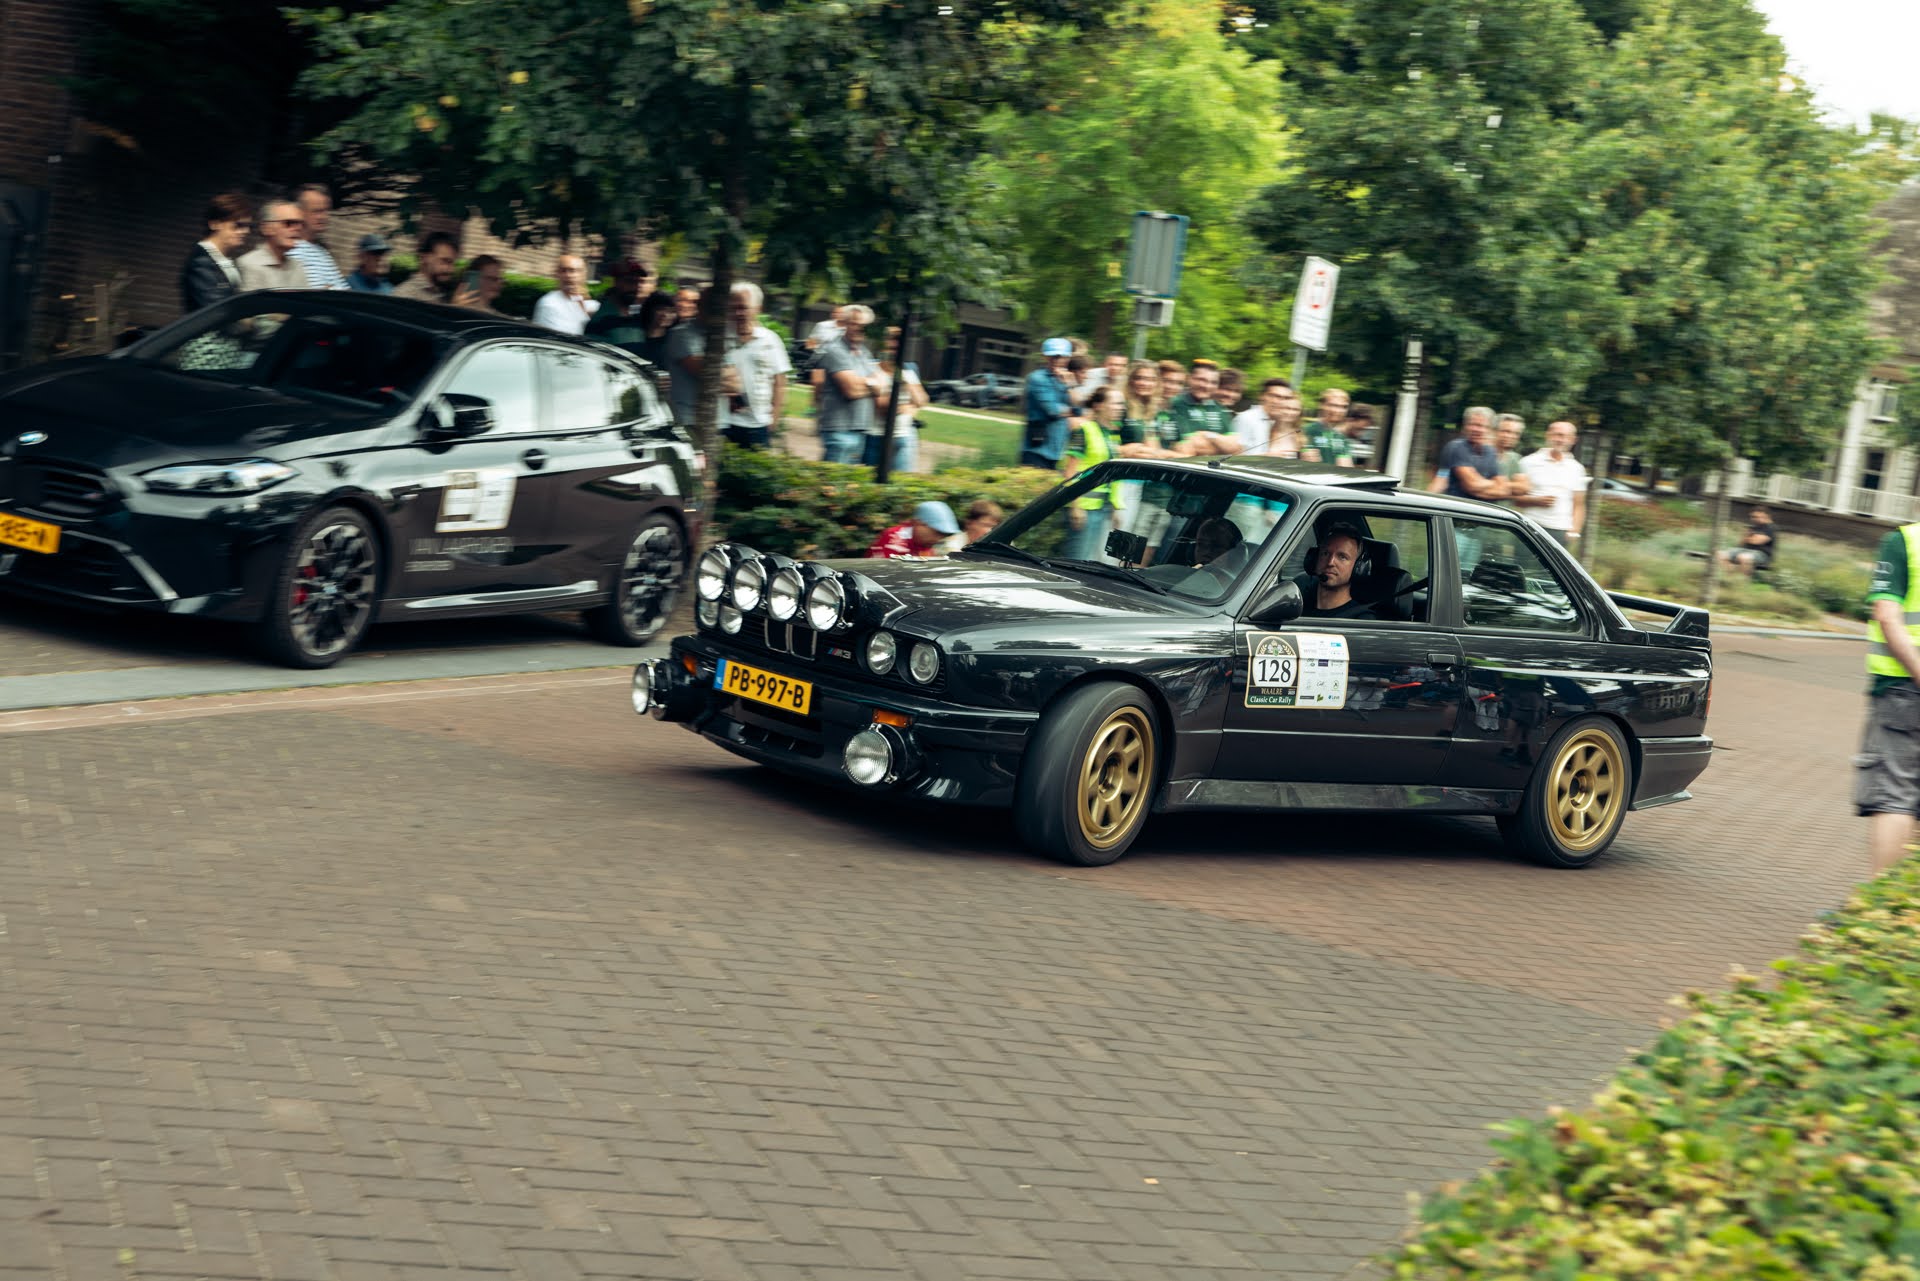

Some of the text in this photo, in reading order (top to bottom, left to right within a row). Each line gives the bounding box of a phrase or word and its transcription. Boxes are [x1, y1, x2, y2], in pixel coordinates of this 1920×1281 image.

[1258, 659, 1291, 683] 128
[729, 665, 805, 708] PB-997-B
[1261, 687, 1283, 695] WAALRE
[1250, 695, 1268, 703] Classic
[1279, 696, 1292, 705] Rally
